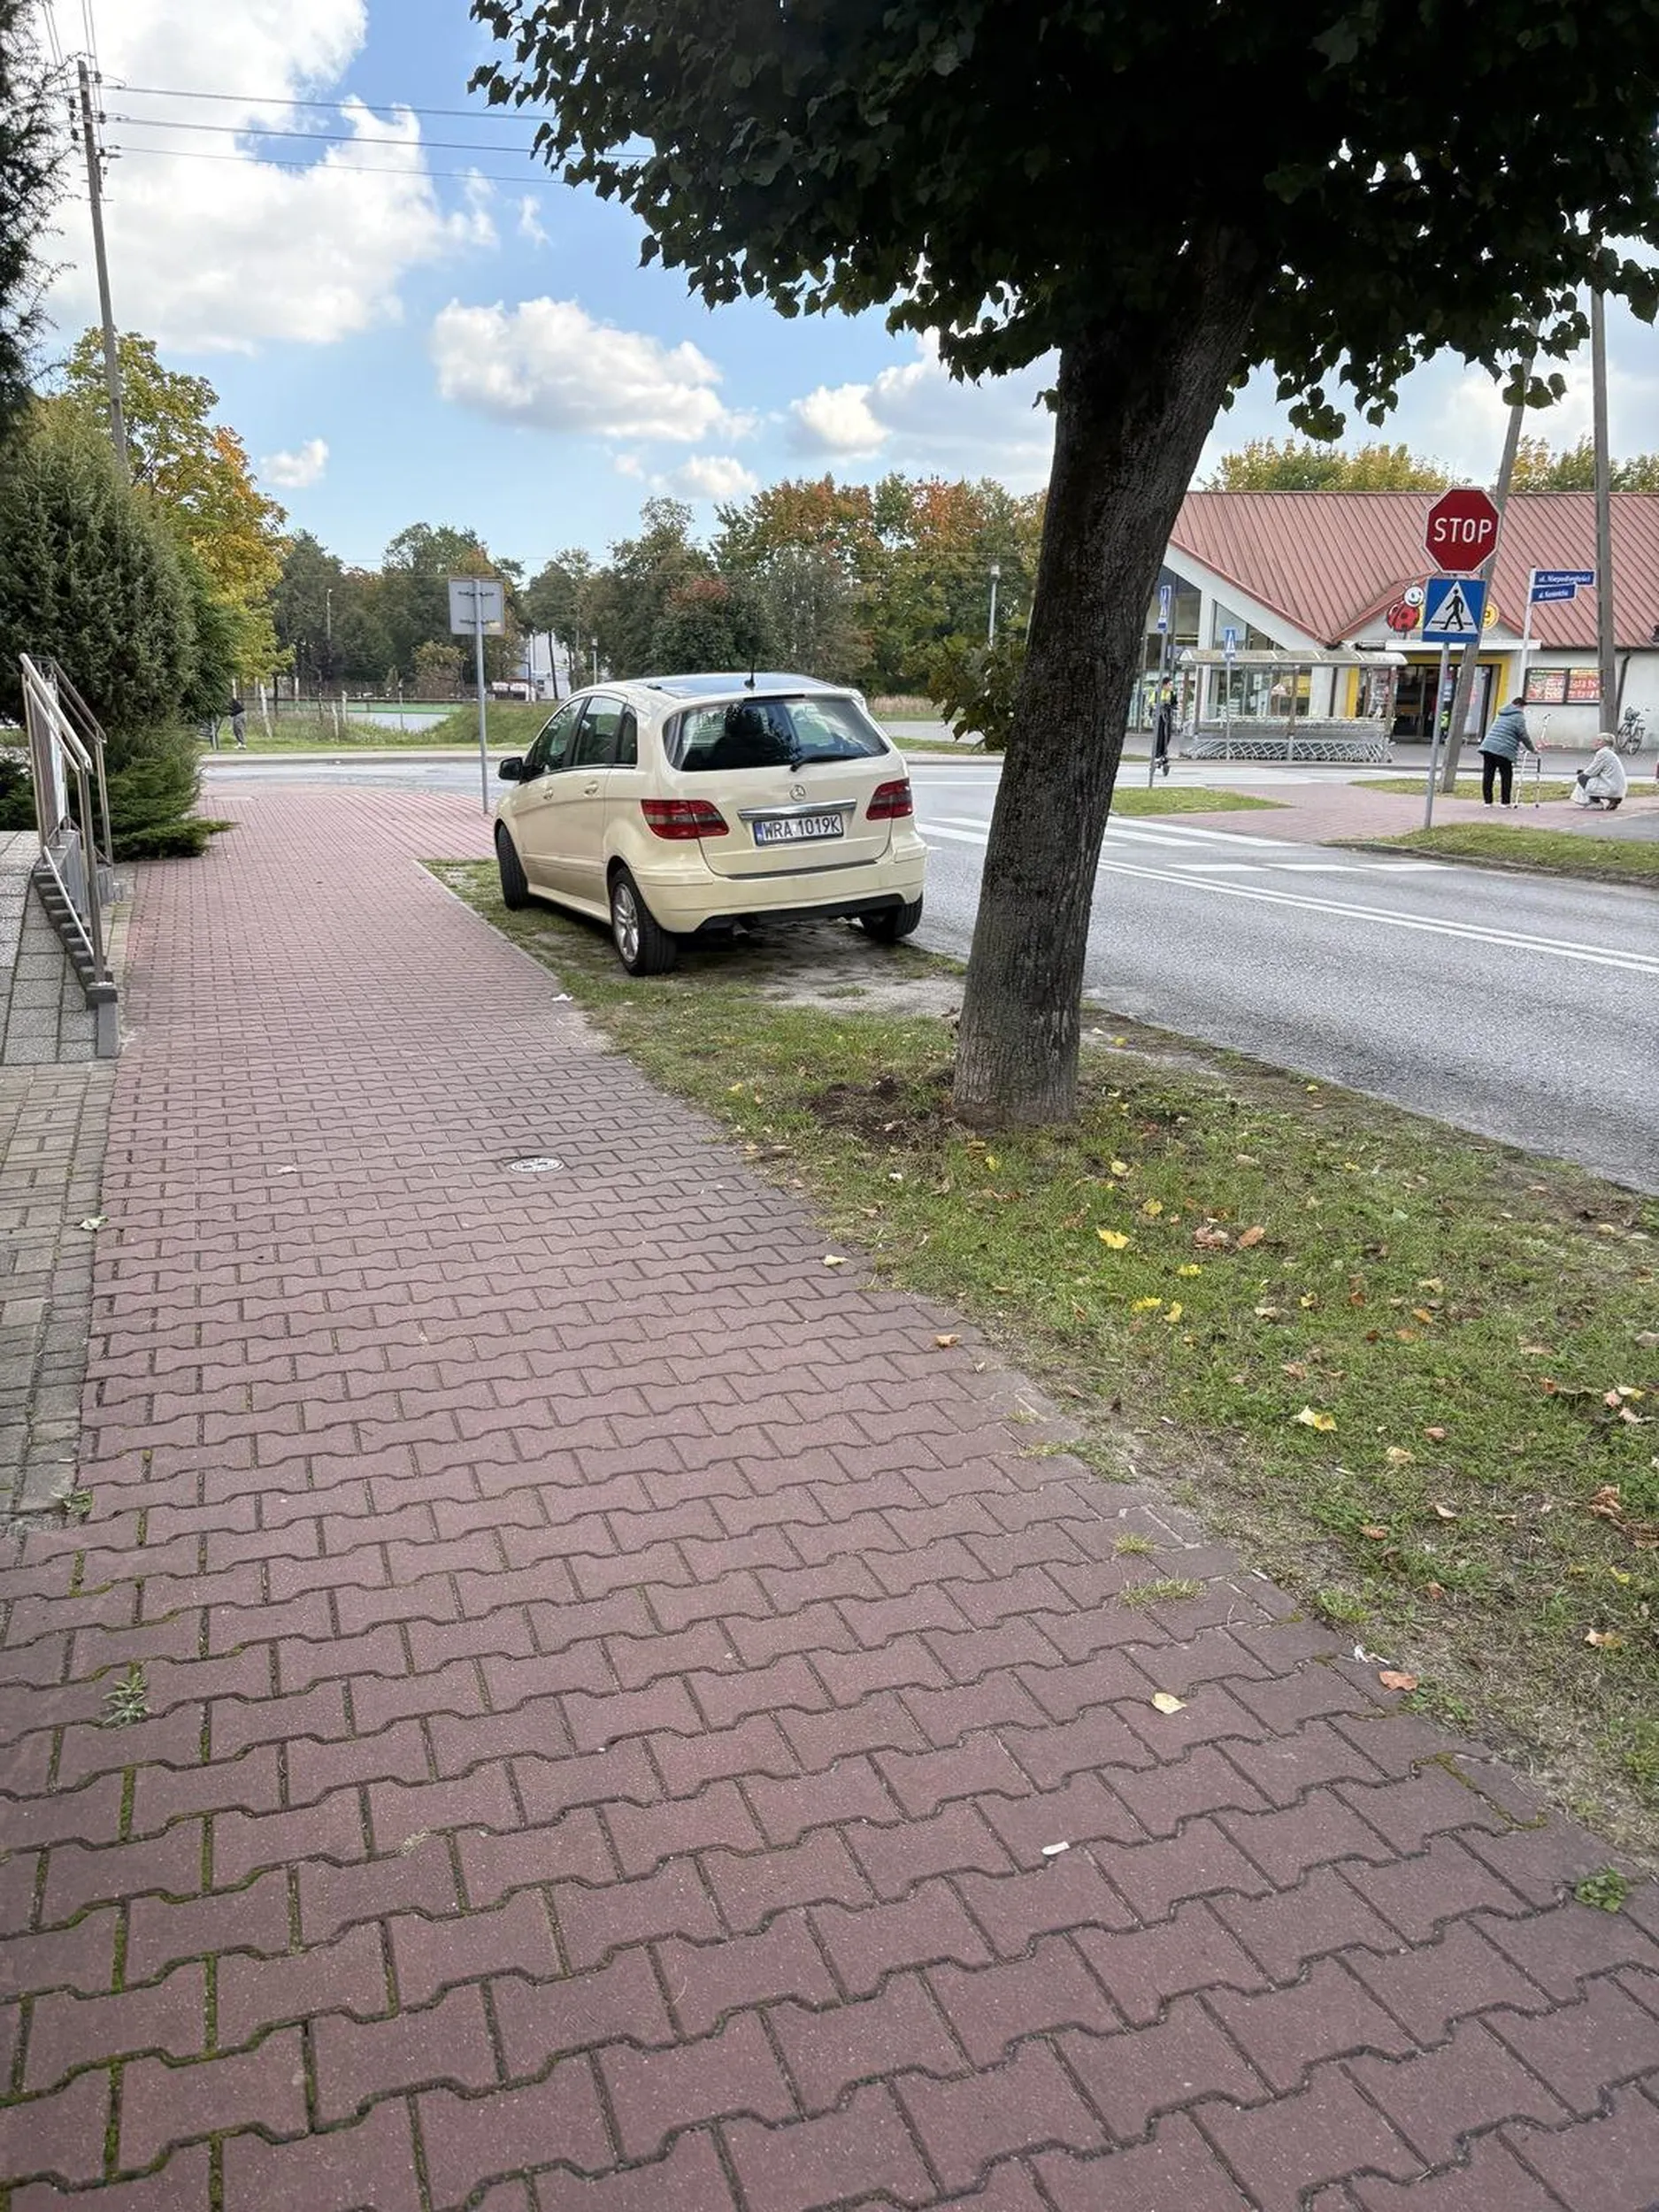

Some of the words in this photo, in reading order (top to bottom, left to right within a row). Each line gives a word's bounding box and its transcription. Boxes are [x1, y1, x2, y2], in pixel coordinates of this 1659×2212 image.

[1433, 517, 1493, 543] STOP
[763, 821, 794, 839] WRA
[797, 816, 841, 835] 1019K
